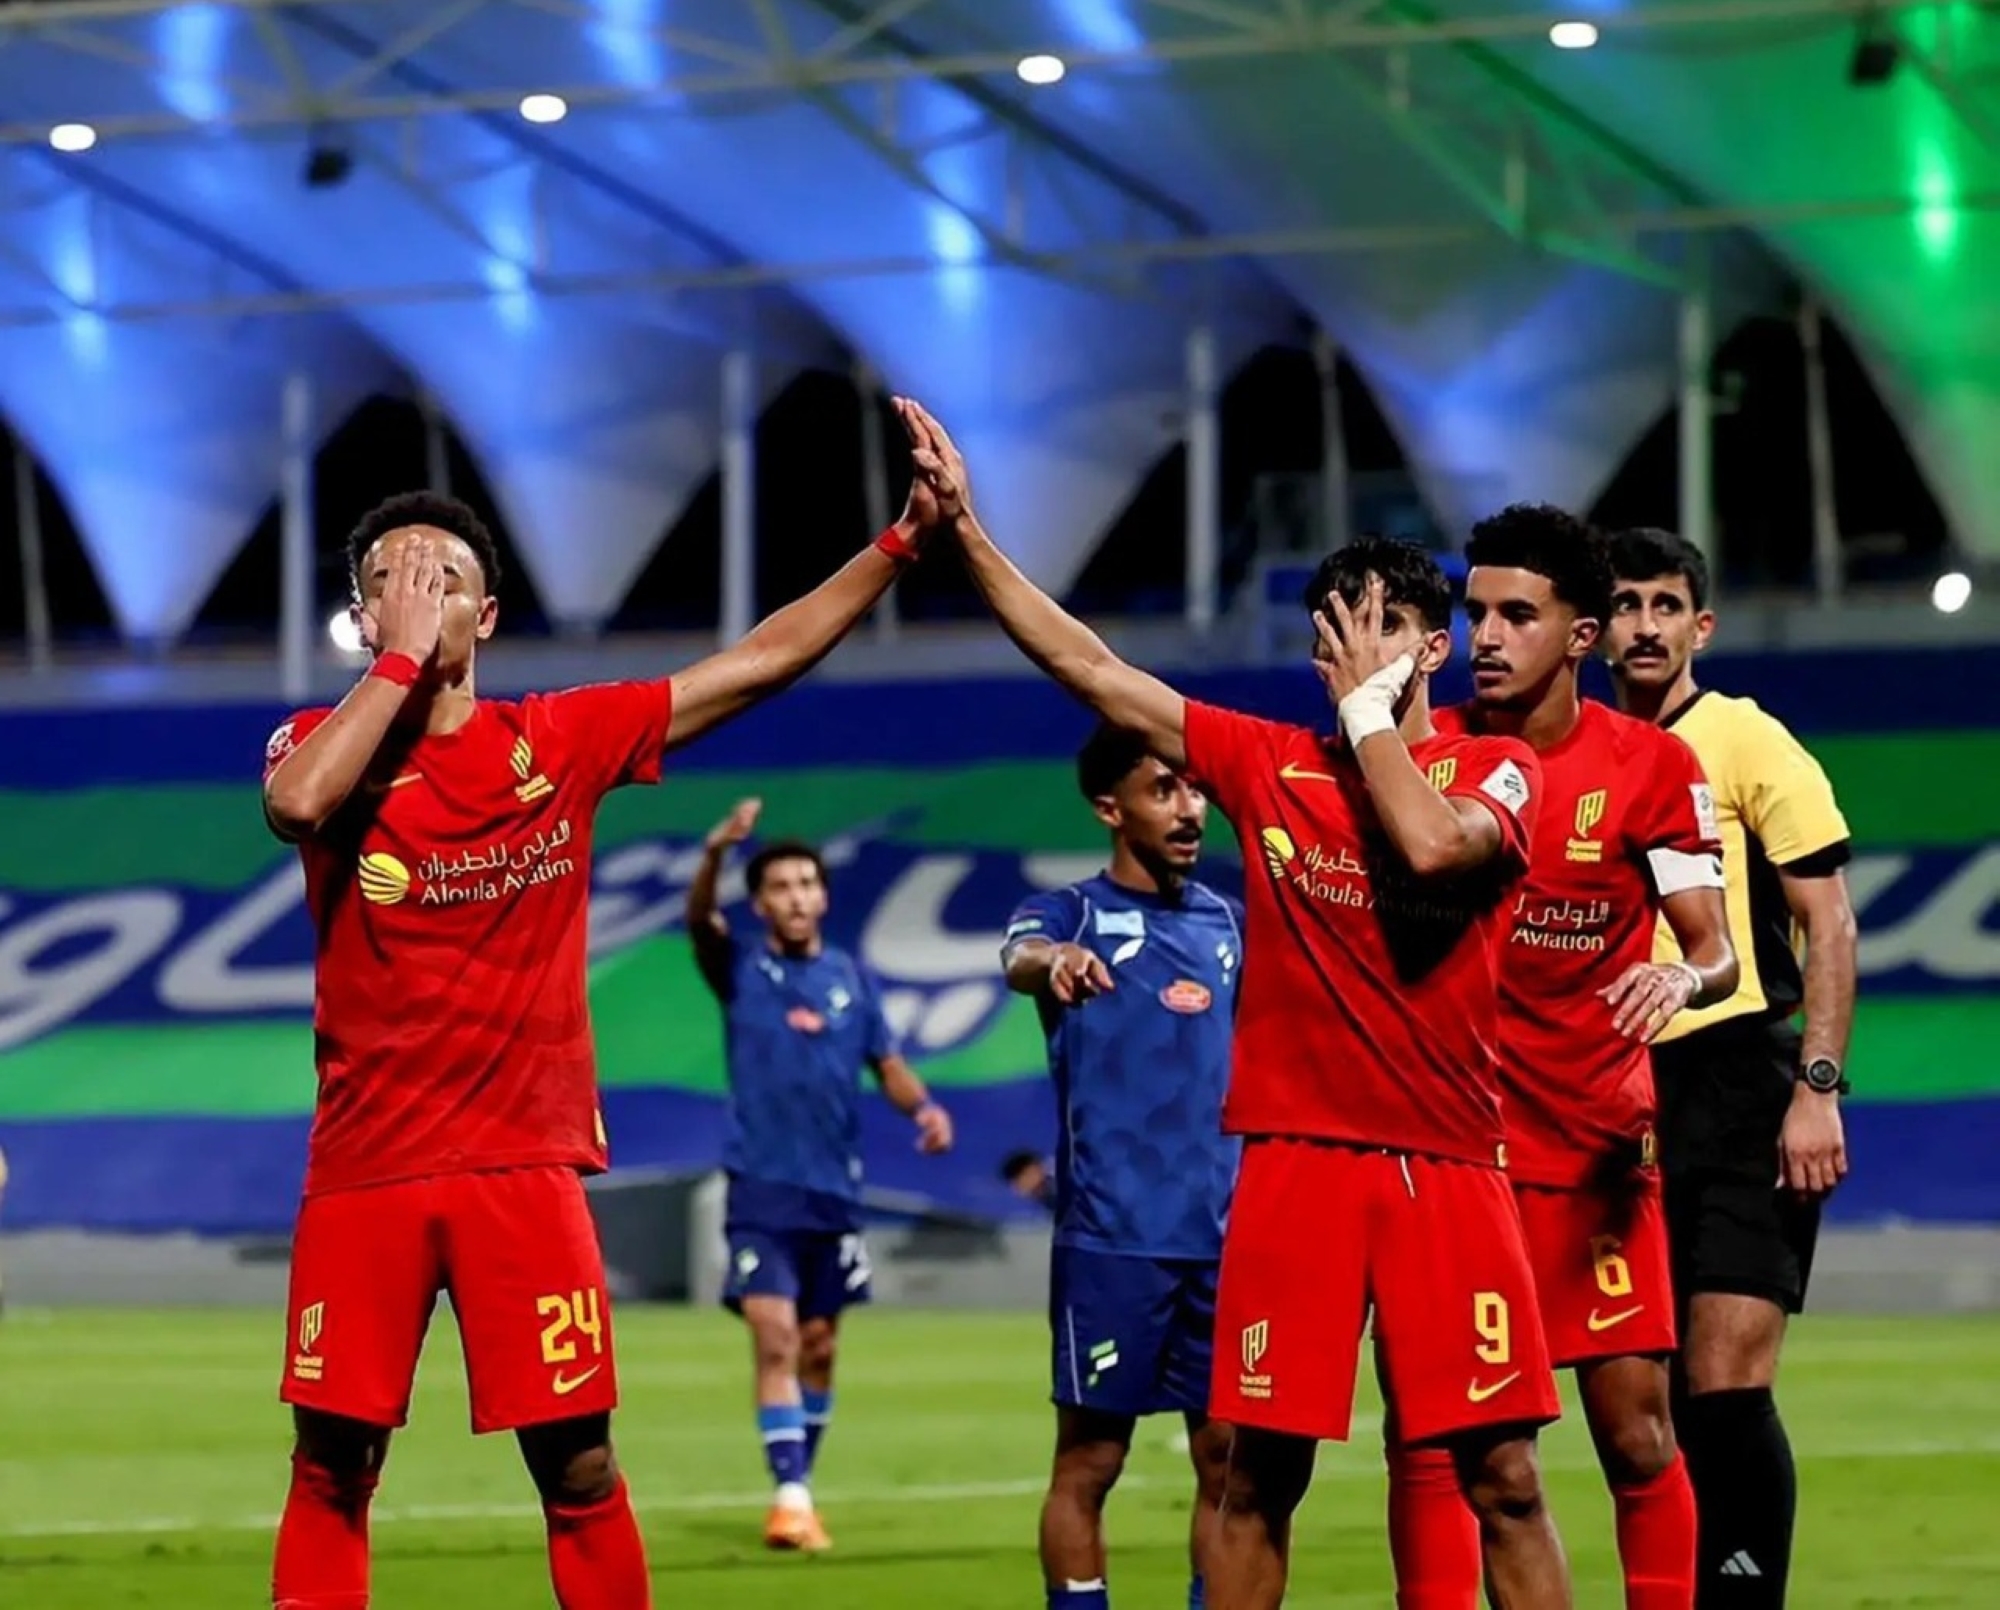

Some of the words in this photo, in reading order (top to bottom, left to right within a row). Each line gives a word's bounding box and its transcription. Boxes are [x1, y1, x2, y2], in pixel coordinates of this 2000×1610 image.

[417, 843, 509, 881] للطيران
[1292, 871, 1365, 908] Aloula
[1511, 926, 1605, 952] Aviation
[1589, 1233, 1633, 1297] 6
[536, 1287, 603, 1363] 24
[1473, 1291, 1510, 1364] 9
